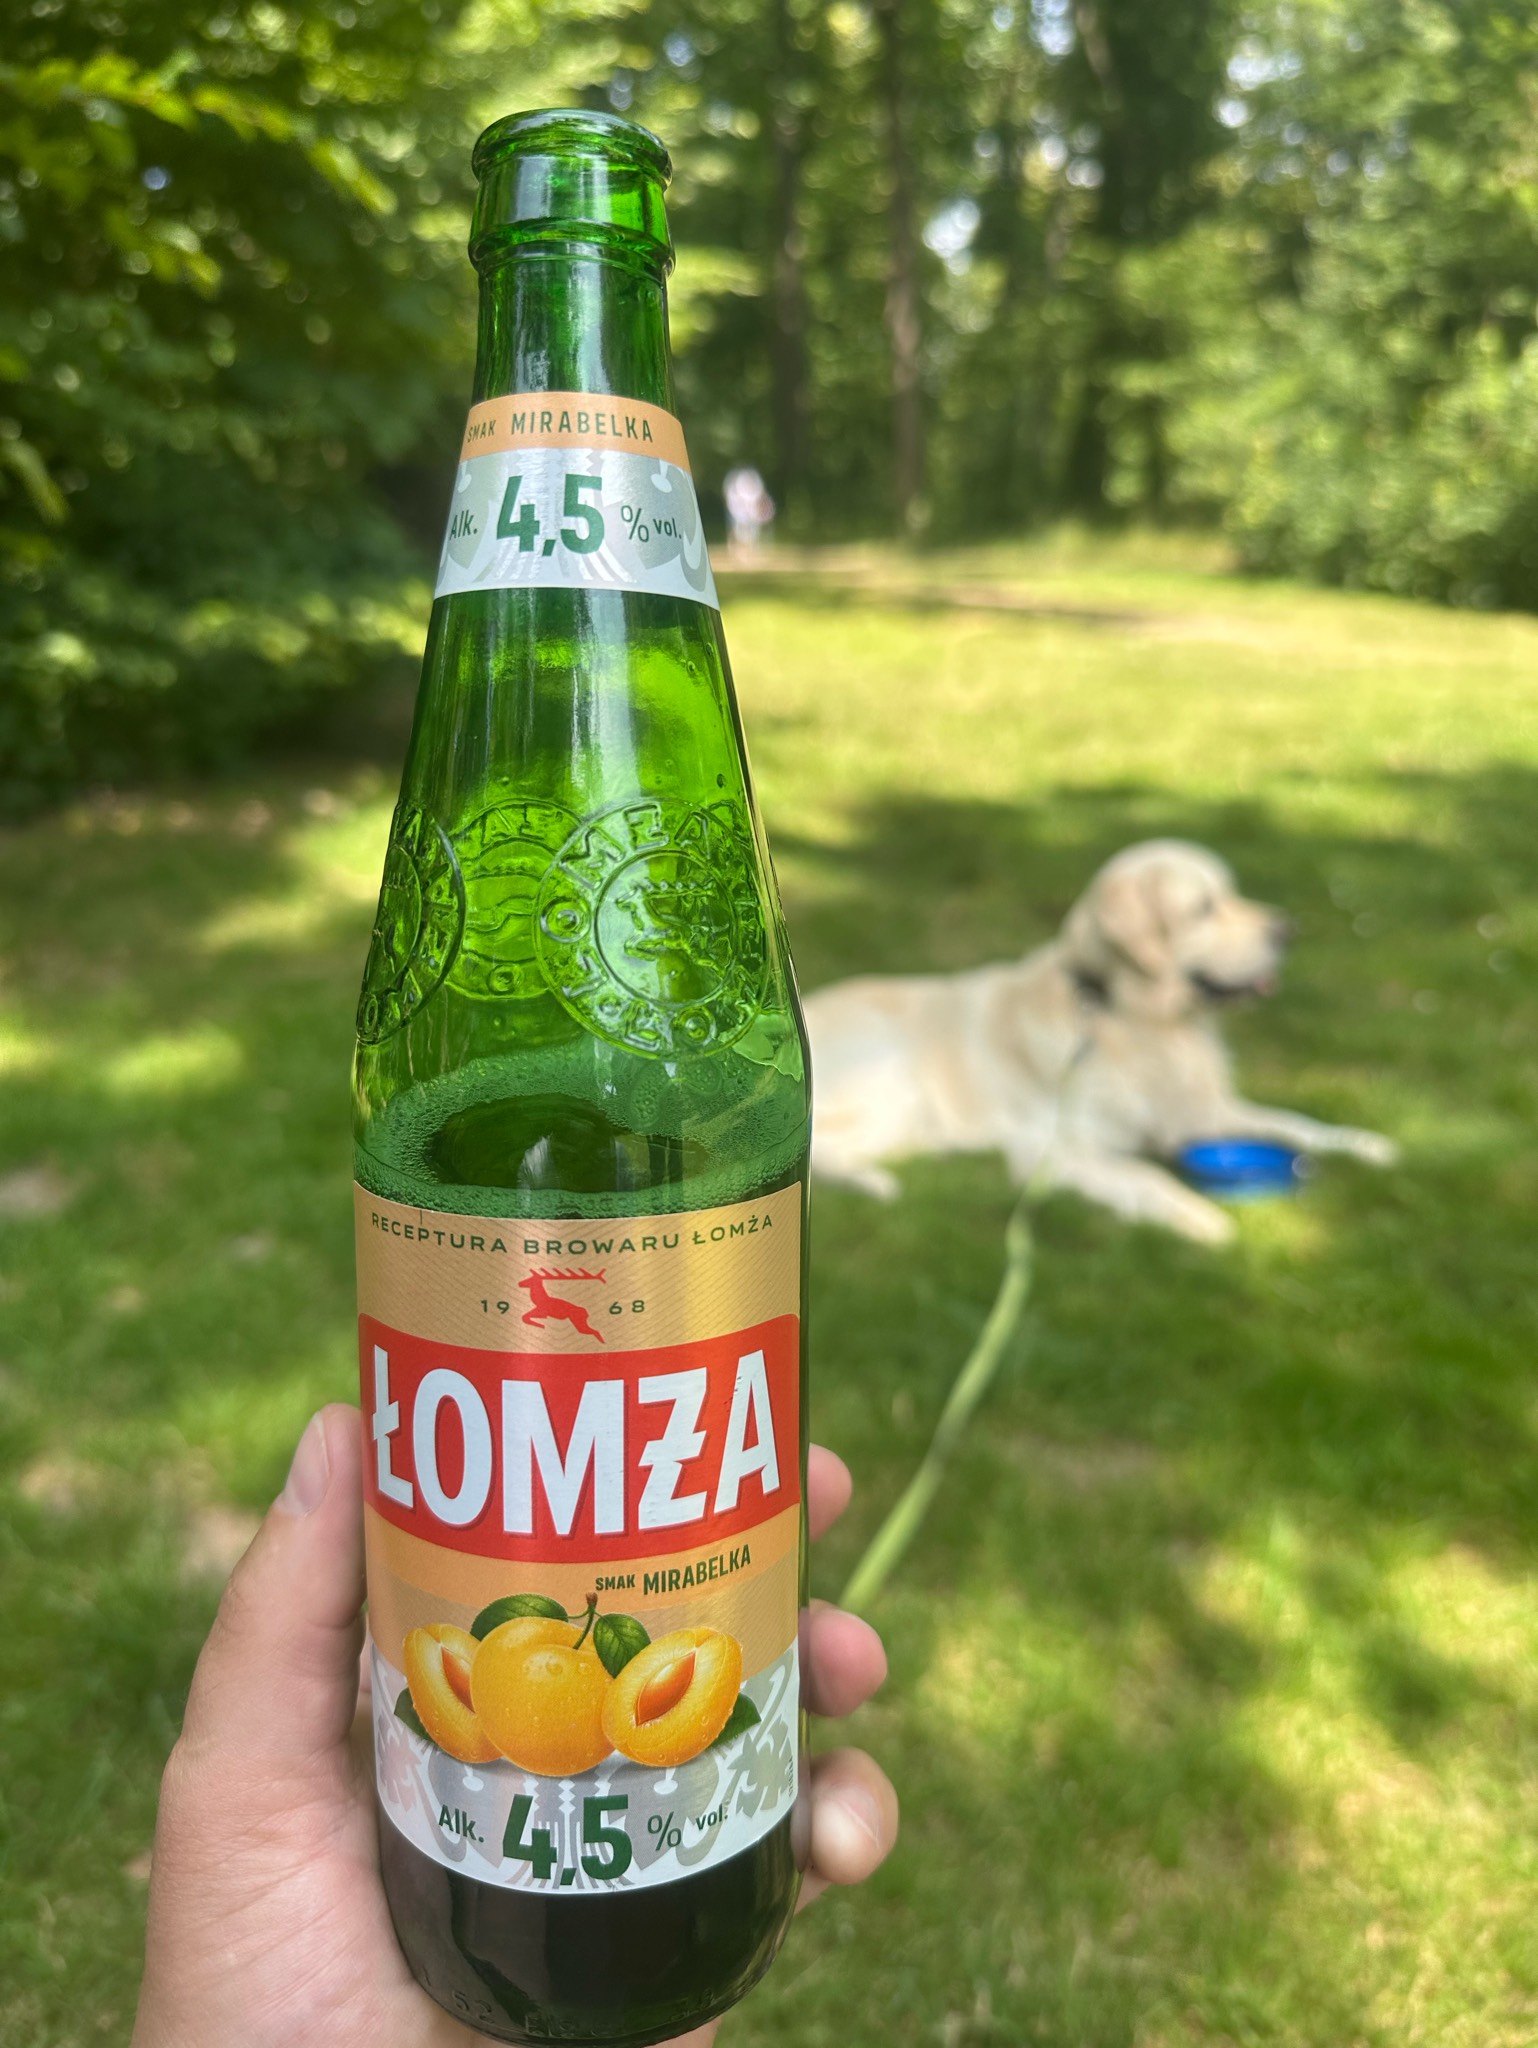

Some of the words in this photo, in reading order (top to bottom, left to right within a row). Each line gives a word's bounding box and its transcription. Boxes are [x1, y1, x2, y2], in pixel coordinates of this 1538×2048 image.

[467, 419, 496, 443] SMAK
[511, 411, 653, 443] MIRABELKA
[449, 510, 478, 541] Alk.
[496, 473, 605, 557] 4,5
[621, 505, 649, 542] %
[653, 518, 682, 540] vol.
[371, 1212, 508, 1254] RECEPTURA
[523, 1233, 679, 1254] BROWARU
[691, 1213, 774, 1246] ŁOMŻA
[481, 1300, 510, 1315] 19
[609, 1299, 646, 1315] 68
[595, 1574, 636, 1591] SMAK
[643, 1544, 752, 1595] MIRABELKA
[438, 1804, 484, 1843] Alk.
[502, 1793, 633, 1886] 4,5
[646, 1811, 682, 1851] %
[695, 1805, 729, 1832] vol.
